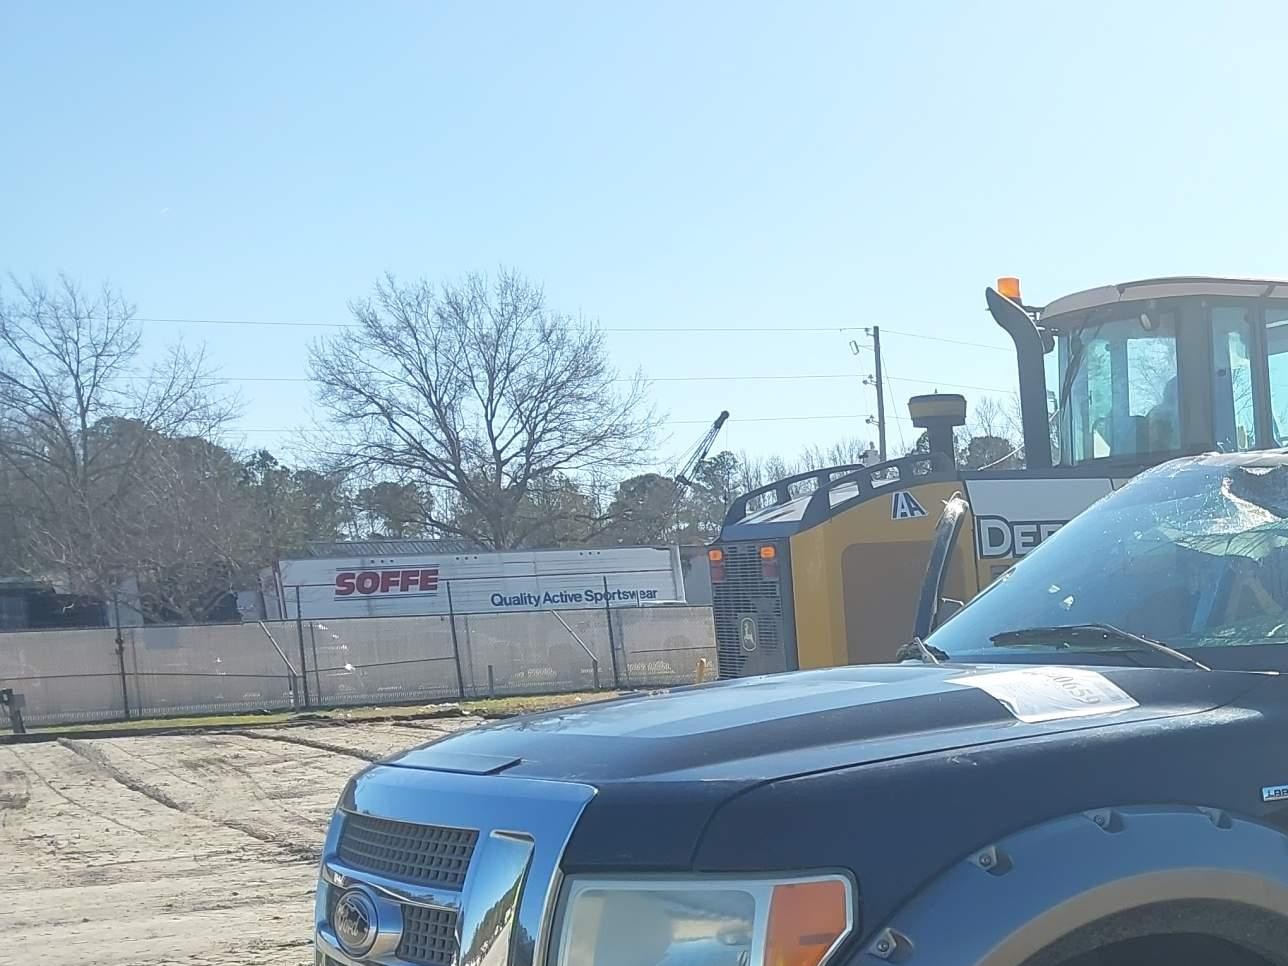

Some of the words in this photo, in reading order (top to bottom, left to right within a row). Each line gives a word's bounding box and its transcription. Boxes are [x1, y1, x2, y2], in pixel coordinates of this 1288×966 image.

[334, 568, 440, 597] SOFFE
[490, 591, 541, 608] Quality
[542, 590, 583, 605] Active
[584, 587, 659, 604] Sportswear
